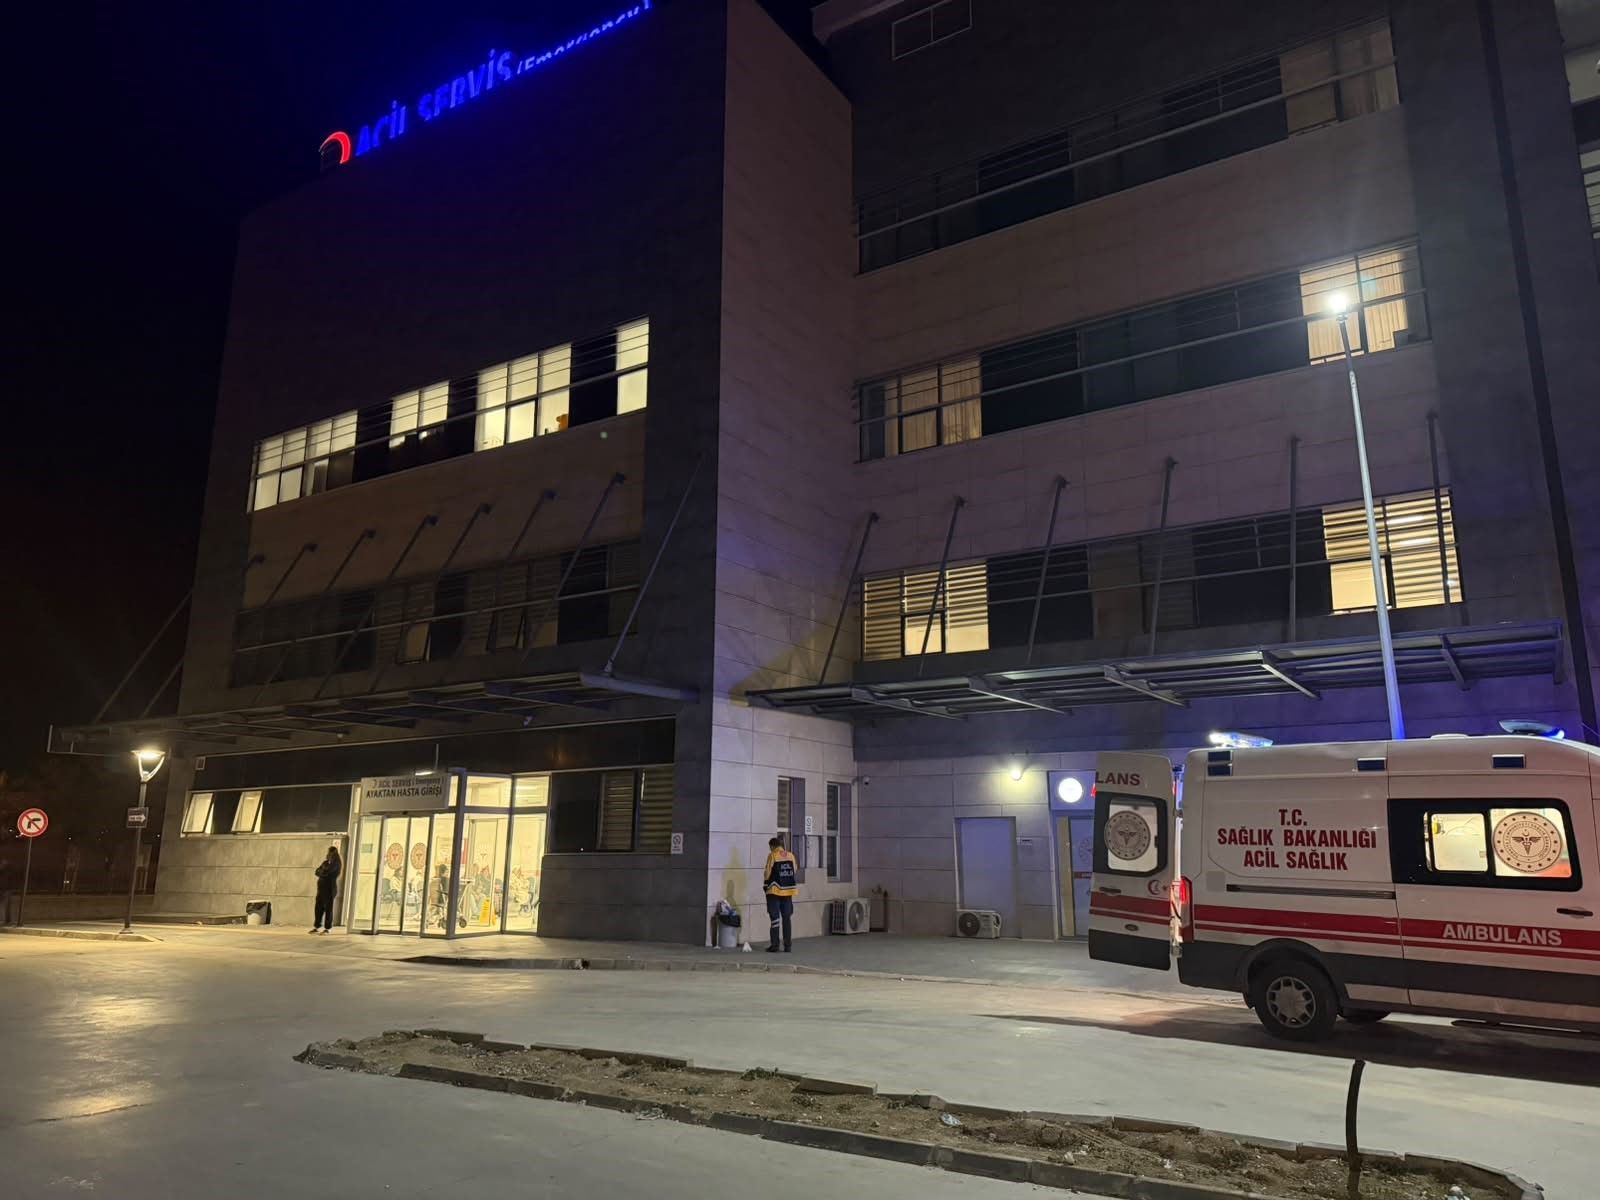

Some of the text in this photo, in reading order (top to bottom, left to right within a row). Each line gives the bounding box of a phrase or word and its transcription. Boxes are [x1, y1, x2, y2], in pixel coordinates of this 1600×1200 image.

[366, 784, 442, 798] AYAKTAN HASTA GİRİŞİ
[1278, 808, 1308, 826] T.C.
[1217, 825, 1377, 849] SAĞLIK BAKANLIĞI
[1243, 847, 1349, 871] ACİL SAĞLIK
[1442, 923, 1562, 946] AMBULANS
